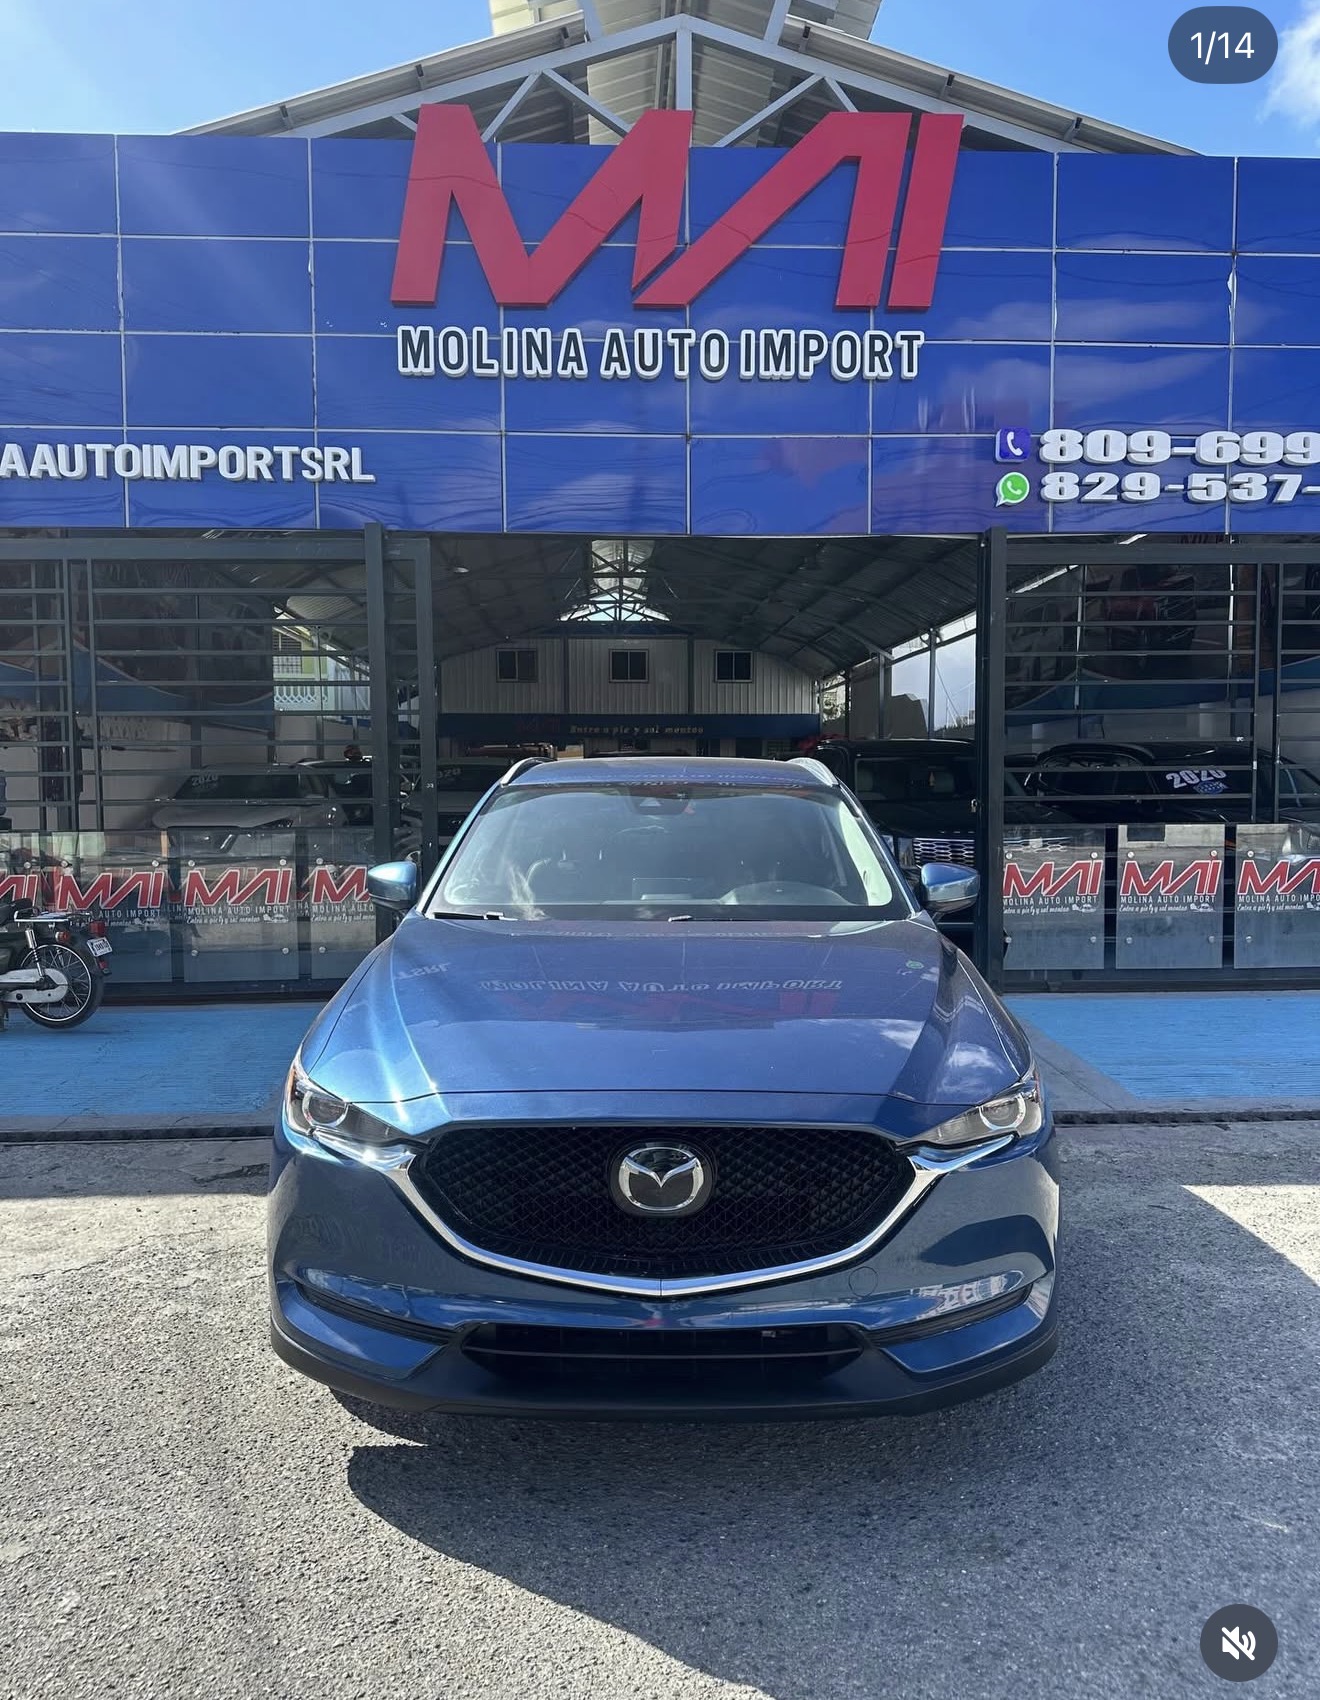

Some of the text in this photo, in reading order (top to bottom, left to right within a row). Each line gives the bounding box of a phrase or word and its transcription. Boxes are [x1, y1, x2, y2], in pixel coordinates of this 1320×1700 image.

[390, 103, 964, 308] MAI
[397, 325, 924, 382] MOLINA AUTO IMPORT
[1040, 429, 1320, 465] 809-699
[57, 871, 165, 910] MAI
[183, 867, 292, 907] MAI
[1003, 859, 1104, 898] MAI
[1119, 859, 1222, 896] MAI
[98, 909, 122, 919] AUTO
[126, 908, 161, 918] IMPORT
[187, 905, 290, 916] MOLINA AUTO IMPORT
[312, 902, 374, 913] MOLINA AUTO
[1038, 896, 1060, 905] AUTO
[1064, 895, 1097, 904] IMPORT
[1120, 894, 1216, 904] MOLINA AUTO IMPORT
[1238, 894, 1271, 903] MOLINA
[1274, 894, 1296, 903] AUTO
